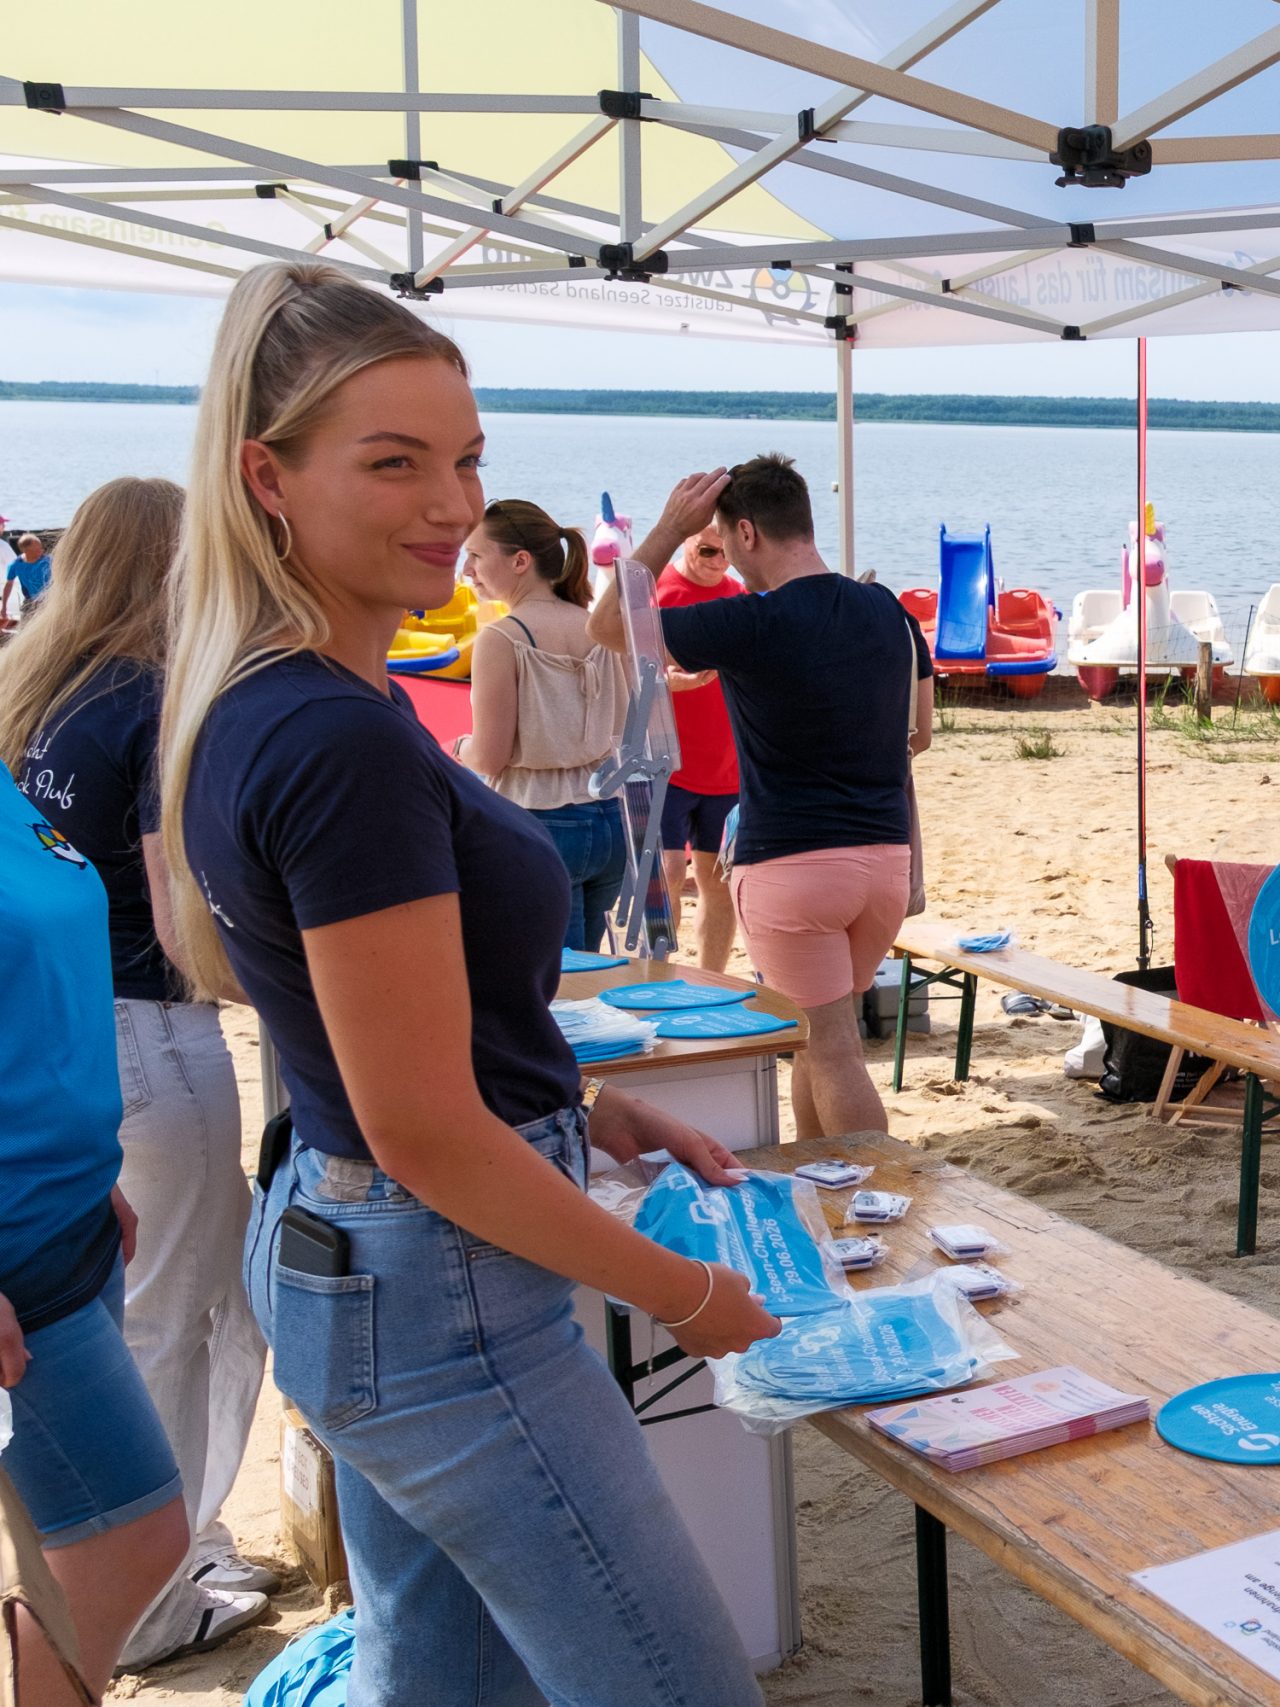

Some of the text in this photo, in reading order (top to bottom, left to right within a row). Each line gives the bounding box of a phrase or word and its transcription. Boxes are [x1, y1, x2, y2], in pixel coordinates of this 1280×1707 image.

[764, 1217, 802, 1286] 29.06.2026
[1190, 1403, 1241, 1437] Sachsen
[1211, 1401, 1259, 1433] Energie
[1242, 1573, 1261, 1583] am
